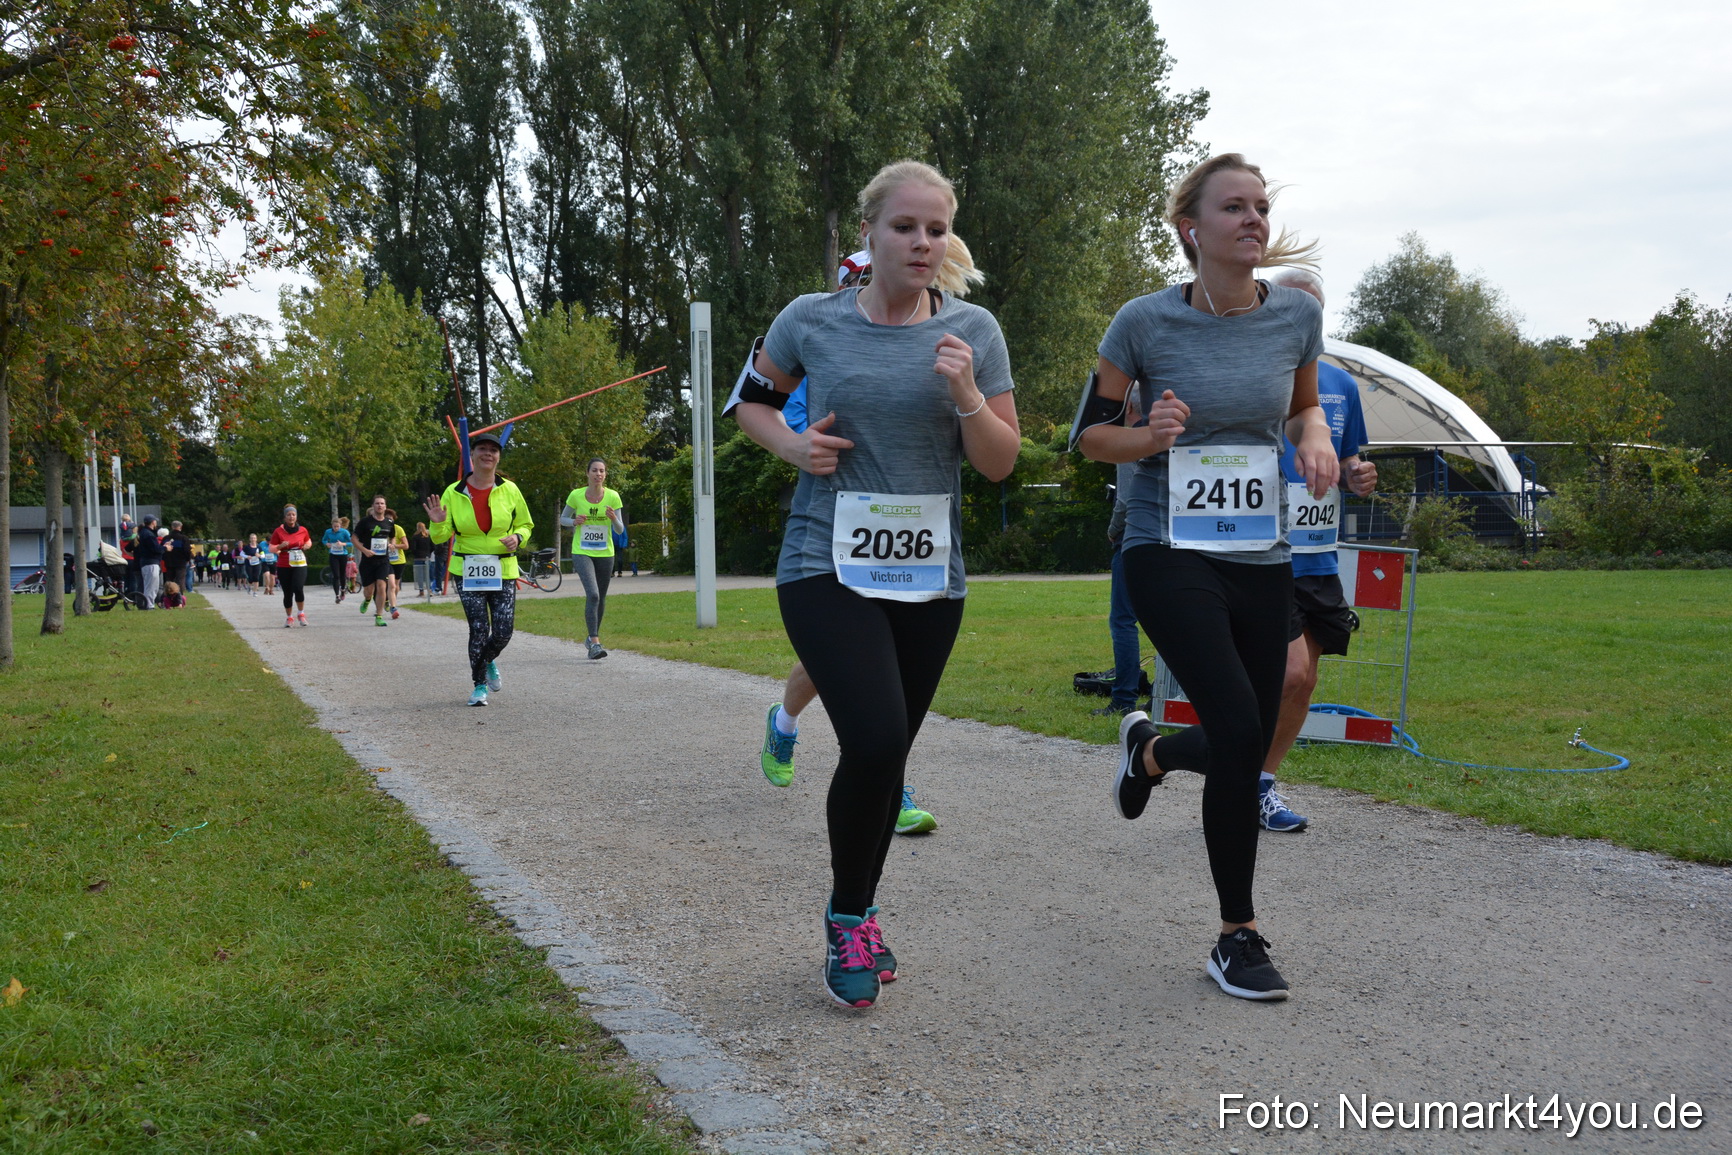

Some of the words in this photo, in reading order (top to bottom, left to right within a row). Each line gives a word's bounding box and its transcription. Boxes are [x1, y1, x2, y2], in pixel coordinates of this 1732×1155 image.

[1212, 455, 1248, 464] BOCK
[1187, 478, 1263, 510] 2416
[882, 505, 921, 514] BOCK
[1296, 504, 1335, 526] 2042
[1217, 521, 1236, 532] Eva
[584, 532, 604, 541] 2094
[1308, 533, 1324, 541] Klaus
[850, 528, 934, 560] 2036
[468, 565, 496, 577] 2189
[870, 571, 913, 583] Victoria
